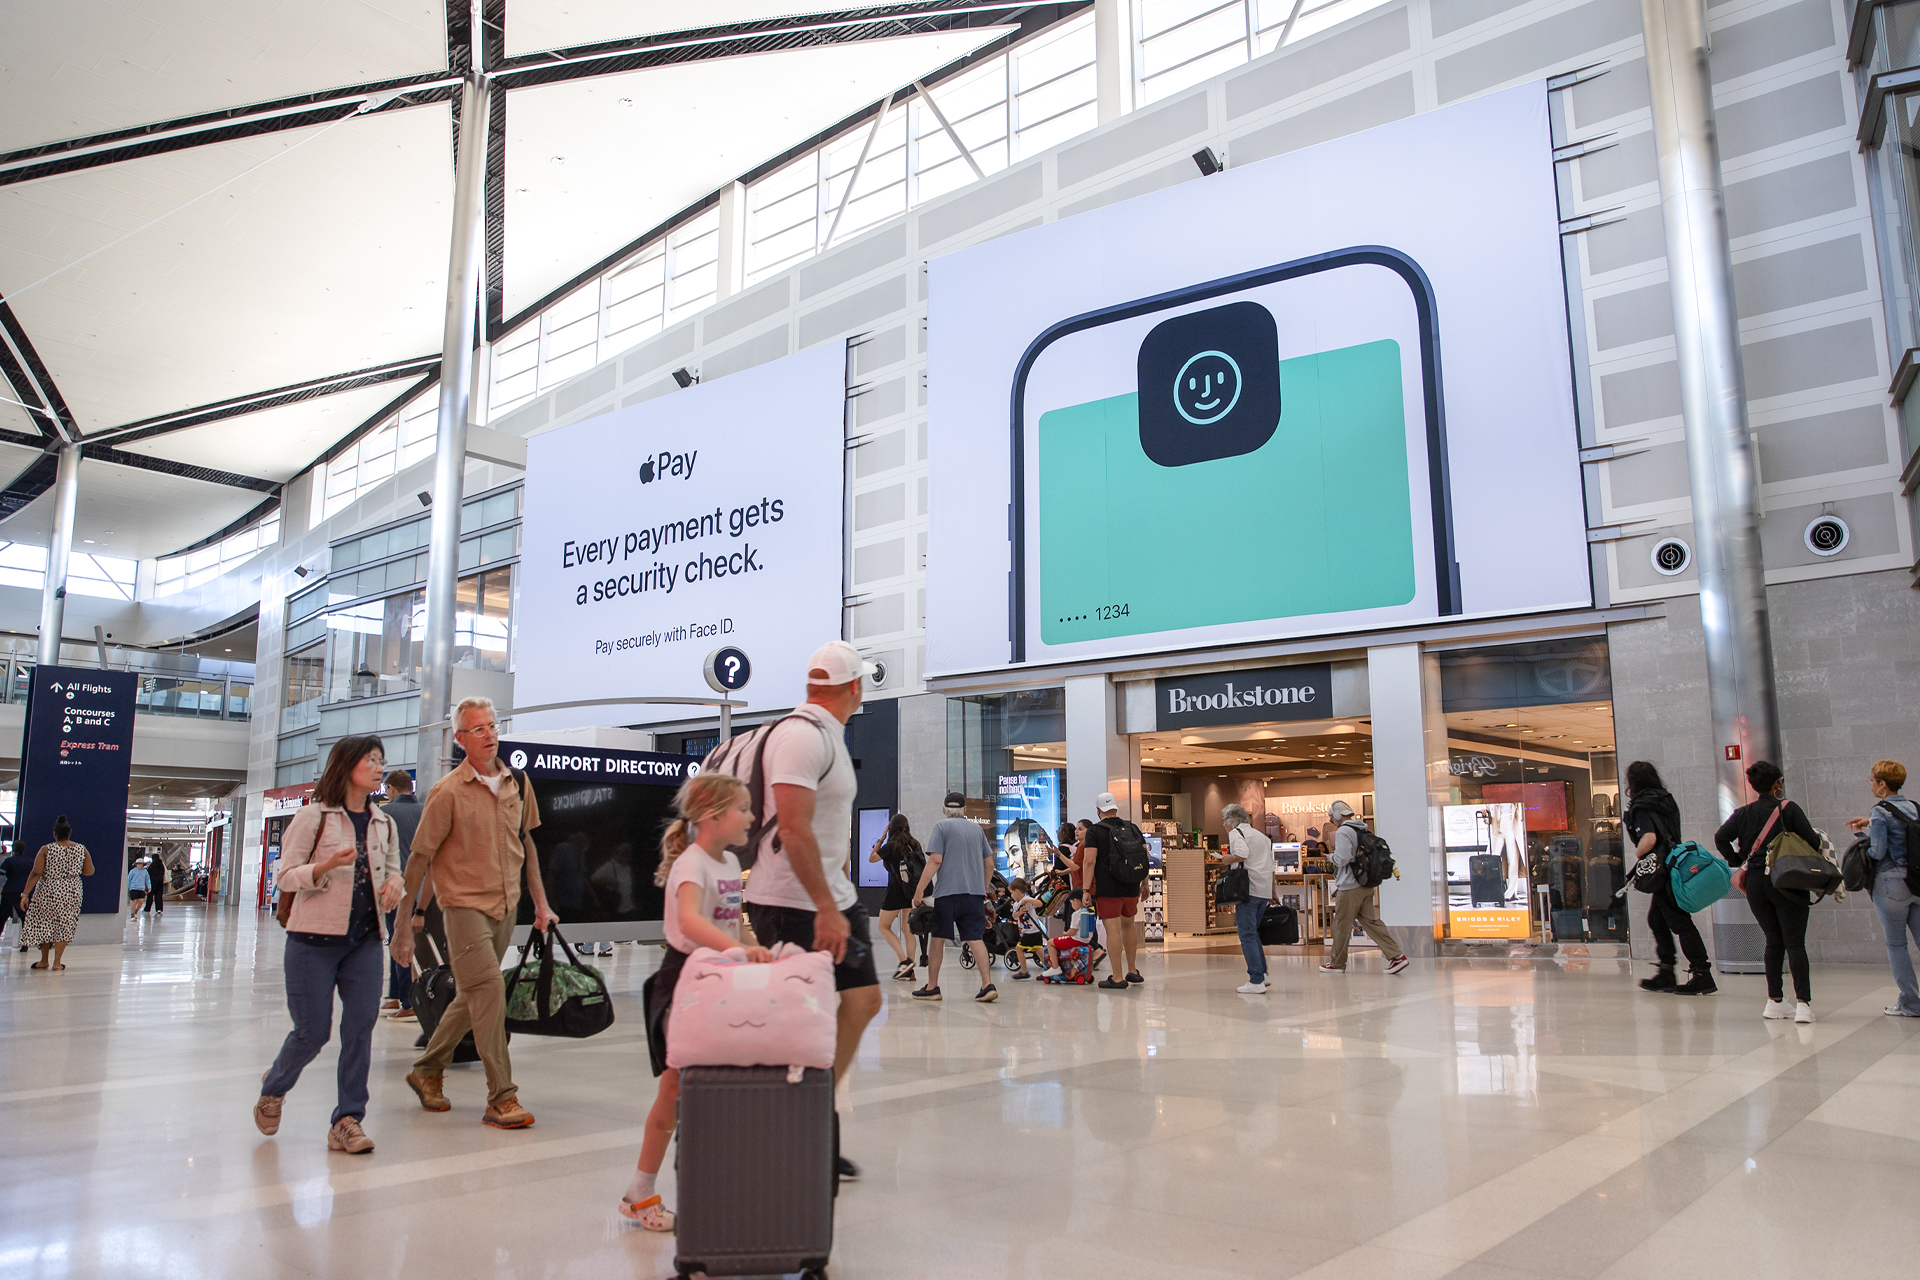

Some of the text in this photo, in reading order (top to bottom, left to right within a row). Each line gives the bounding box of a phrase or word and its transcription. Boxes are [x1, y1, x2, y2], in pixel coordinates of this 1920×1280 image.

[657, 450, 698, 481] Pay
[562, 496, 784, 569] Every payment gets
[576, 543, 764, 606] a security check.
[1095, 603, 1130, 621] 1234
[595, 617, 735, 656] Pay securely with Face ID.
[66, 682, 112, 694] All Flights
[1168, 682, 1316, 714] Brookstone
[64, 706, 116, 718] Concourses
[63, 715, 111, 727] A, B and C
[60, 740, 119, 751] Express Tram
[533, 753, 601, 773] AIRPORT
[605, 758, 683, 777] DIRECTORY
[998, 774, 1028, 786] Pause for
[998, 784, 1022, 796] nothing
[1281, 801, 1332, 814] Brooksto
